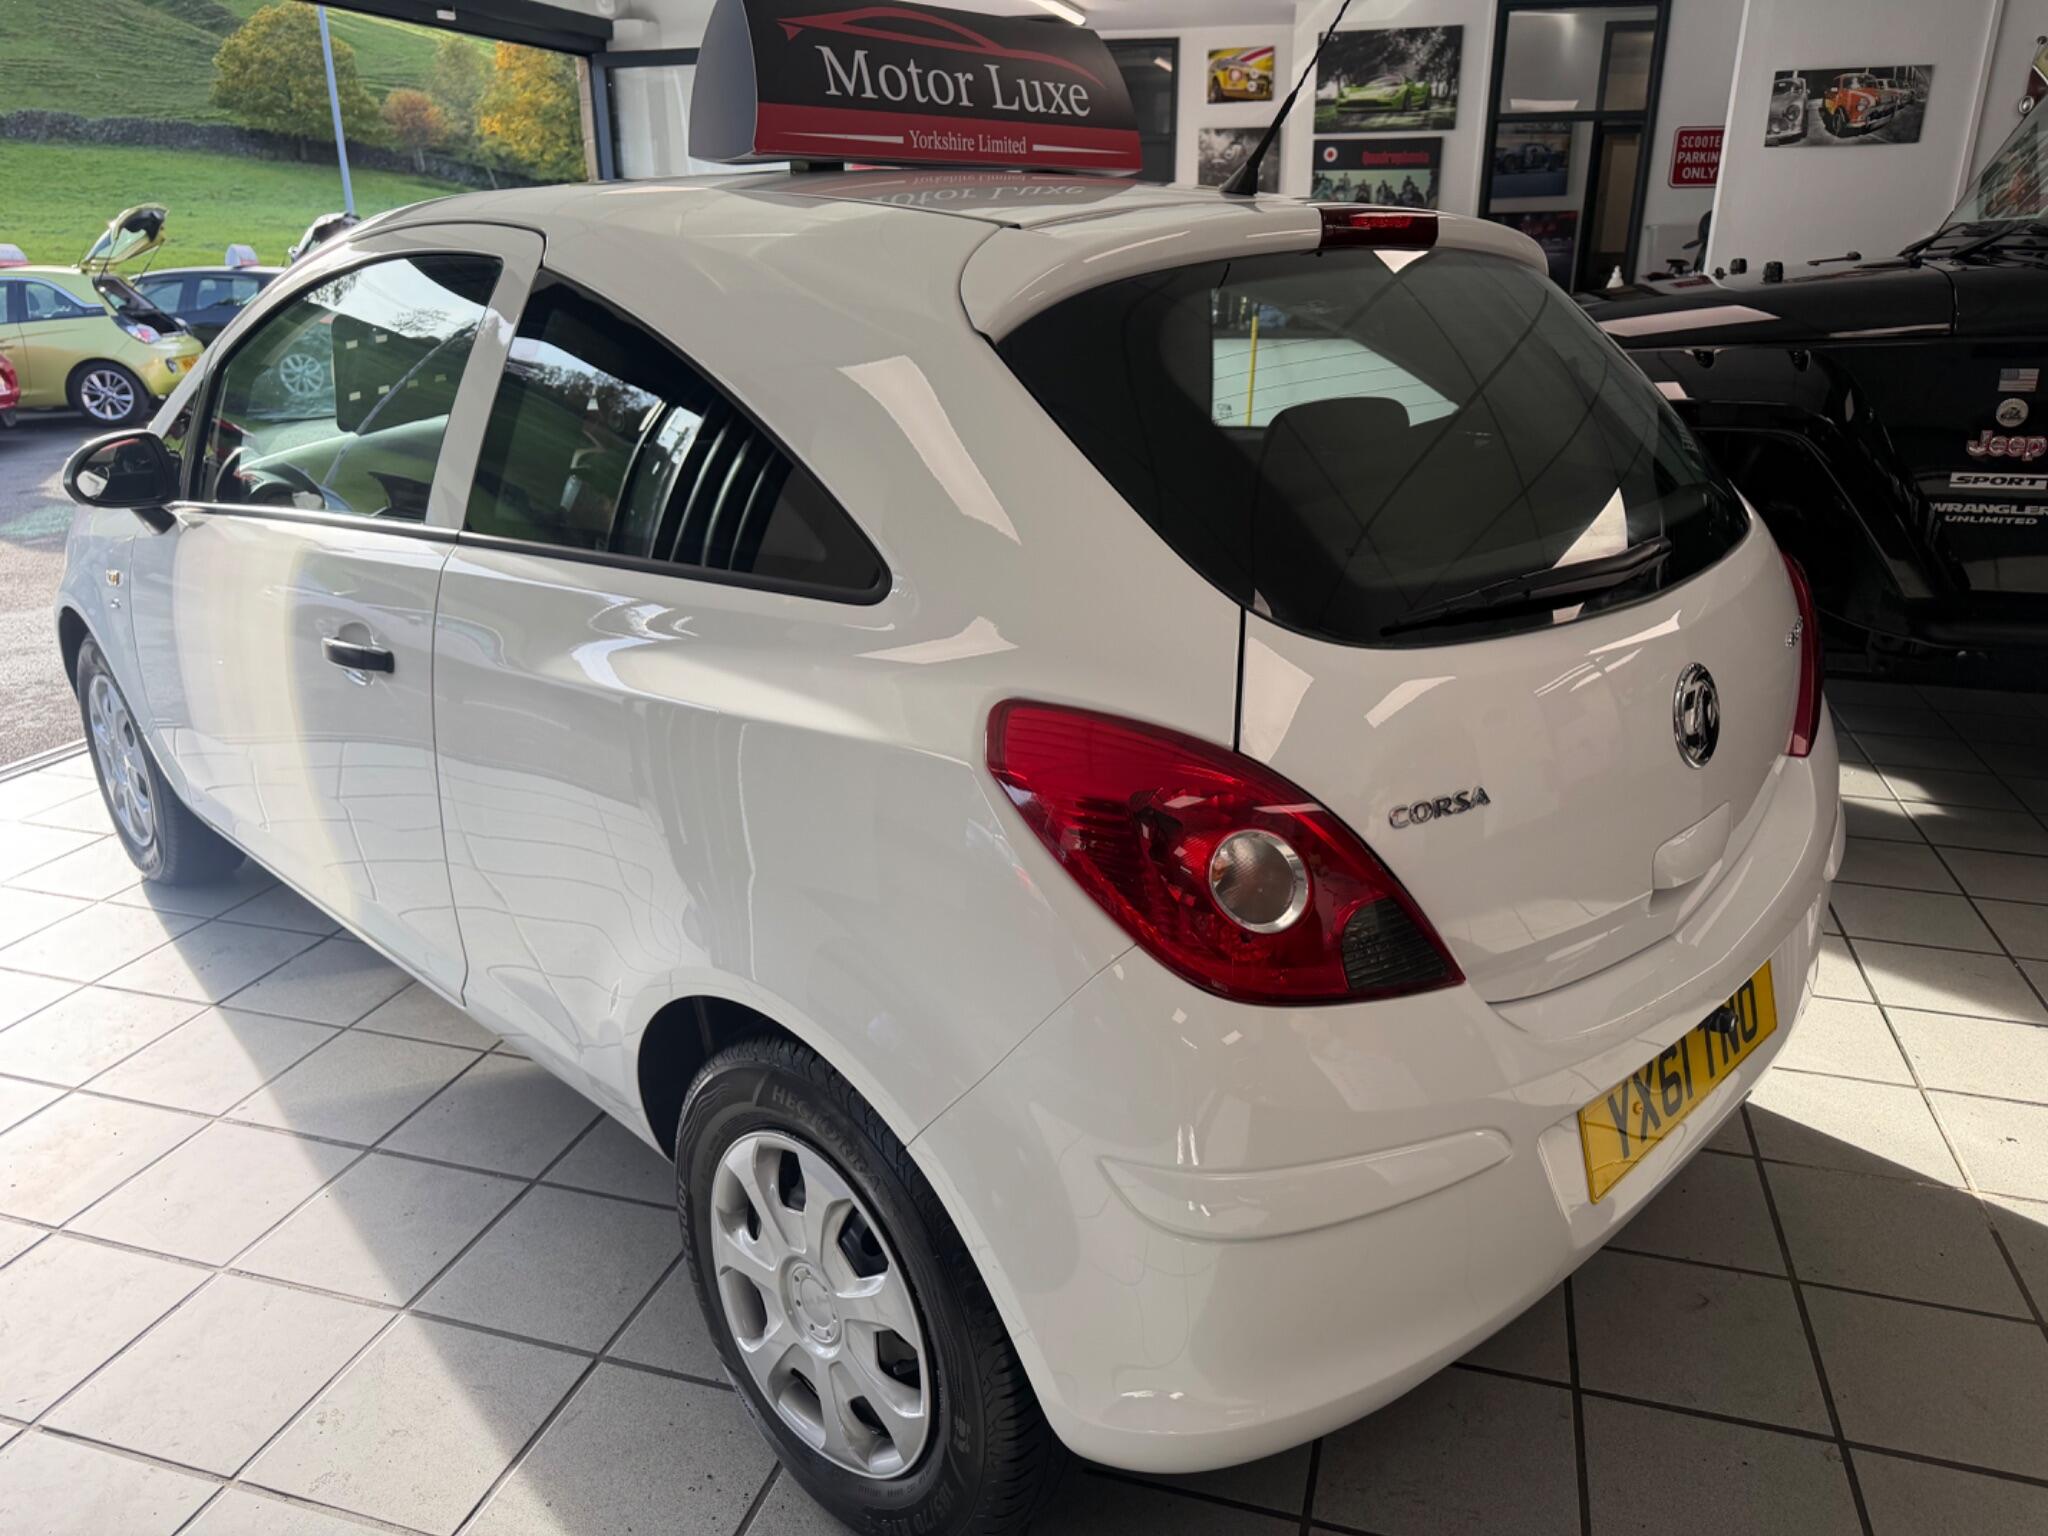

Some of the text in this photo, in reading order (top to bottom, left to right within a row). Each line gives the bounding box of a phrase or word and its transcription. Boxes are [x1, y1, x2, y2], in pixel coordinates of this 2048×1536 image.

[815, 45, 1092, 117] Motor Luxe
[909, 130, 1026, 155] Yorkshire Limited
[1680, 135, 1721, 148] SCOOTE
[1677, 151, 1719, 164] PARKIN
[1682, 167, 1718, 179] ONLY
[1966, 430, 2047, 461] Jeep
[1955, 475, 2043, 486] SPORT
[1929, 502, 2048, 516] WRANGLER
[1945, 514, 2038, 526] UNLIMITED
[1388, 786, 1491, 829] CORSA
[1607, 1037, 1693, 1160] YX61
